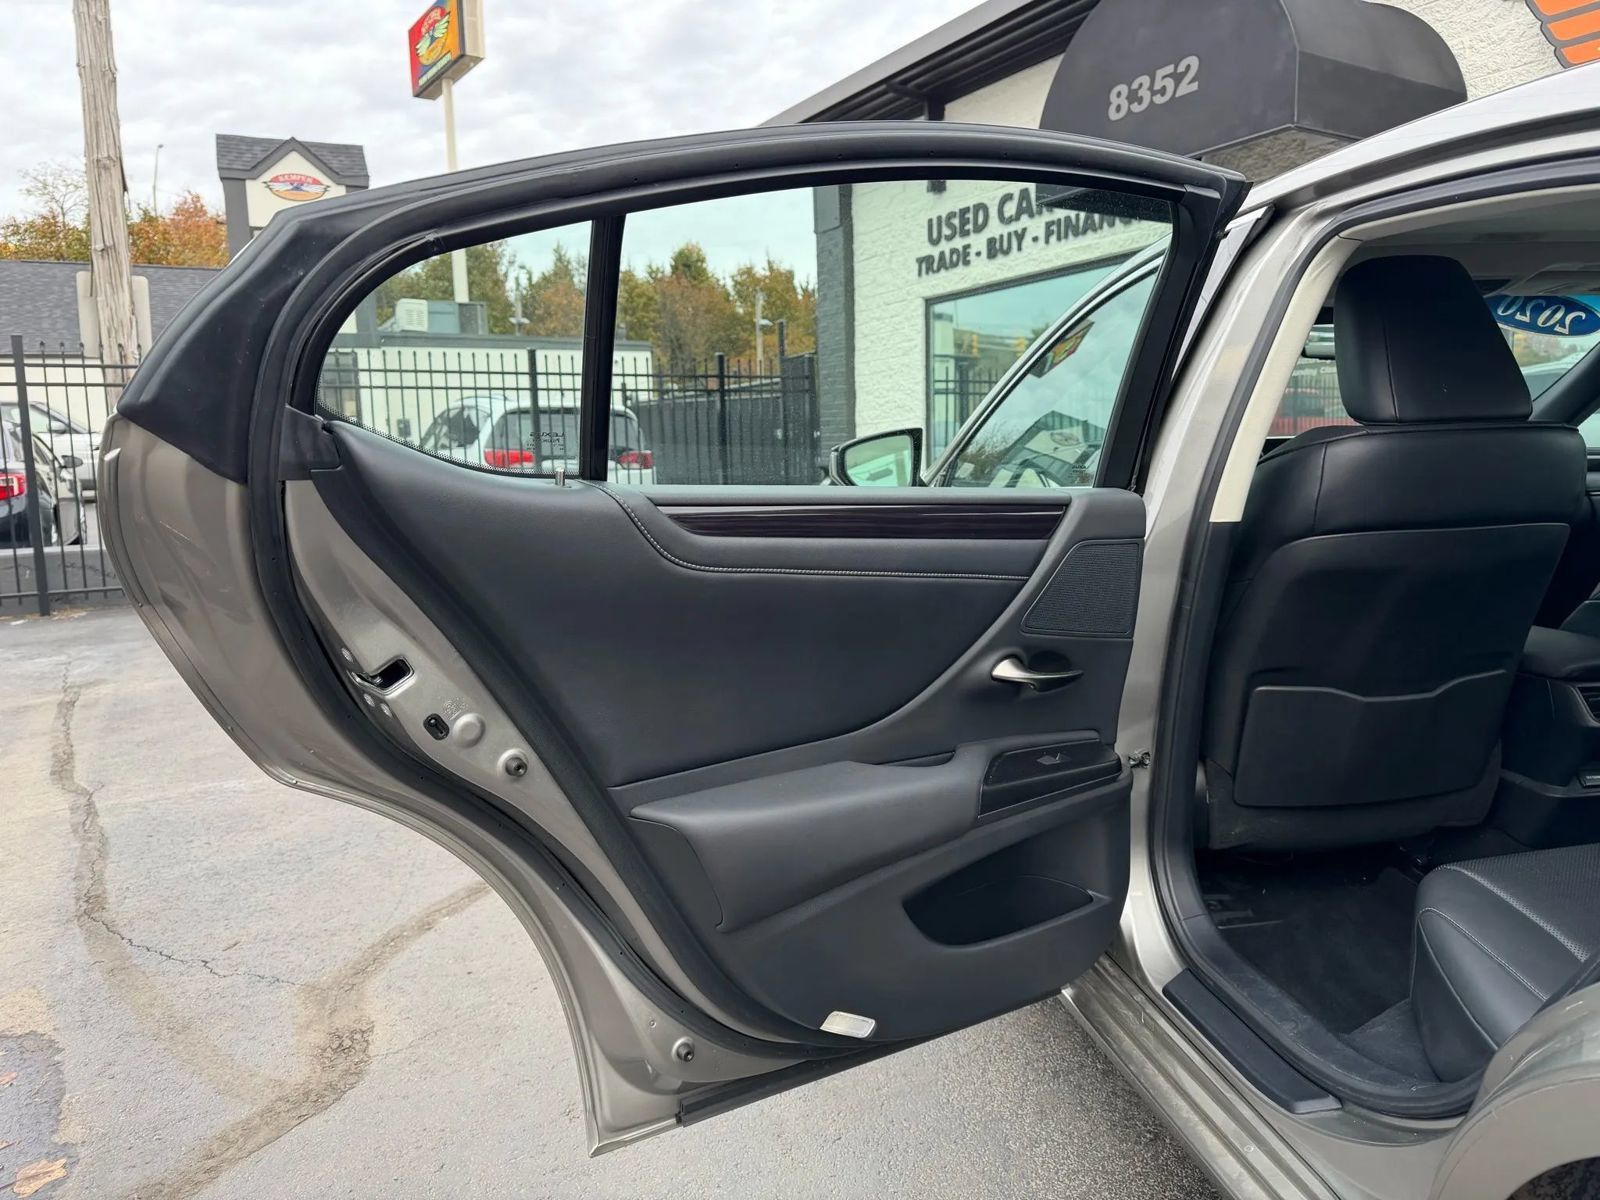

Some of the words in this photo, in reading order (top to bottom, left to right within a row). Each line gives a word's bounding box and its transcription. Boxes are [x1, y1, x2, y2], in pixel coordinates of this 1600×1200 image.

[1108, 55, 1199, 121] 8352
[927, 202, 990, 246] USED
[916, 244, 971, 278] TRADE
[986, 228, 1027, 260] BUY
